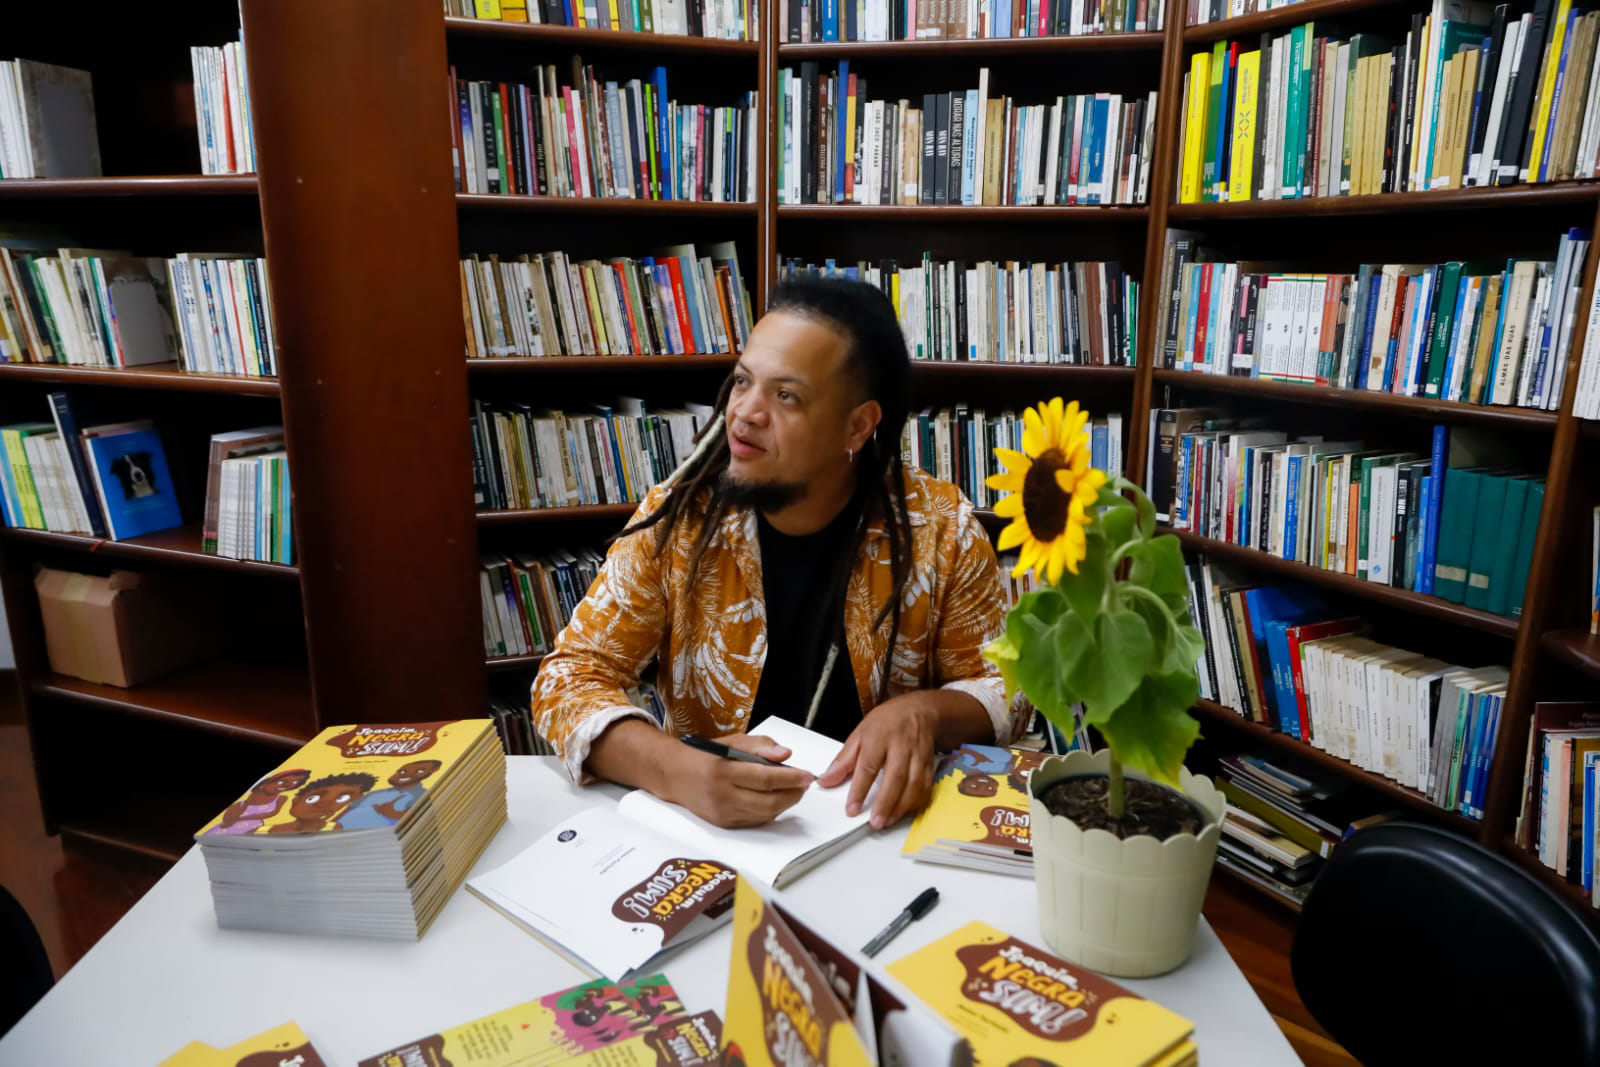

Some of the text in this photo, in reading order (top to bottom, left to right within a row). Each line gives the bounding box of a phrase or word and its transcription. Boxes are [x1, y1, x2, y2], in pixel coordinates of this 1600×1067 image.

[953, 97, 964, 123] MORAR
[951, 123, 962, 138] NAS
[951, 138, 962, 168] ALTURAS
[1500, 324, 1516, 386] ALMAS DAS RUAS
[623, 864, 687, 918] SIM!
